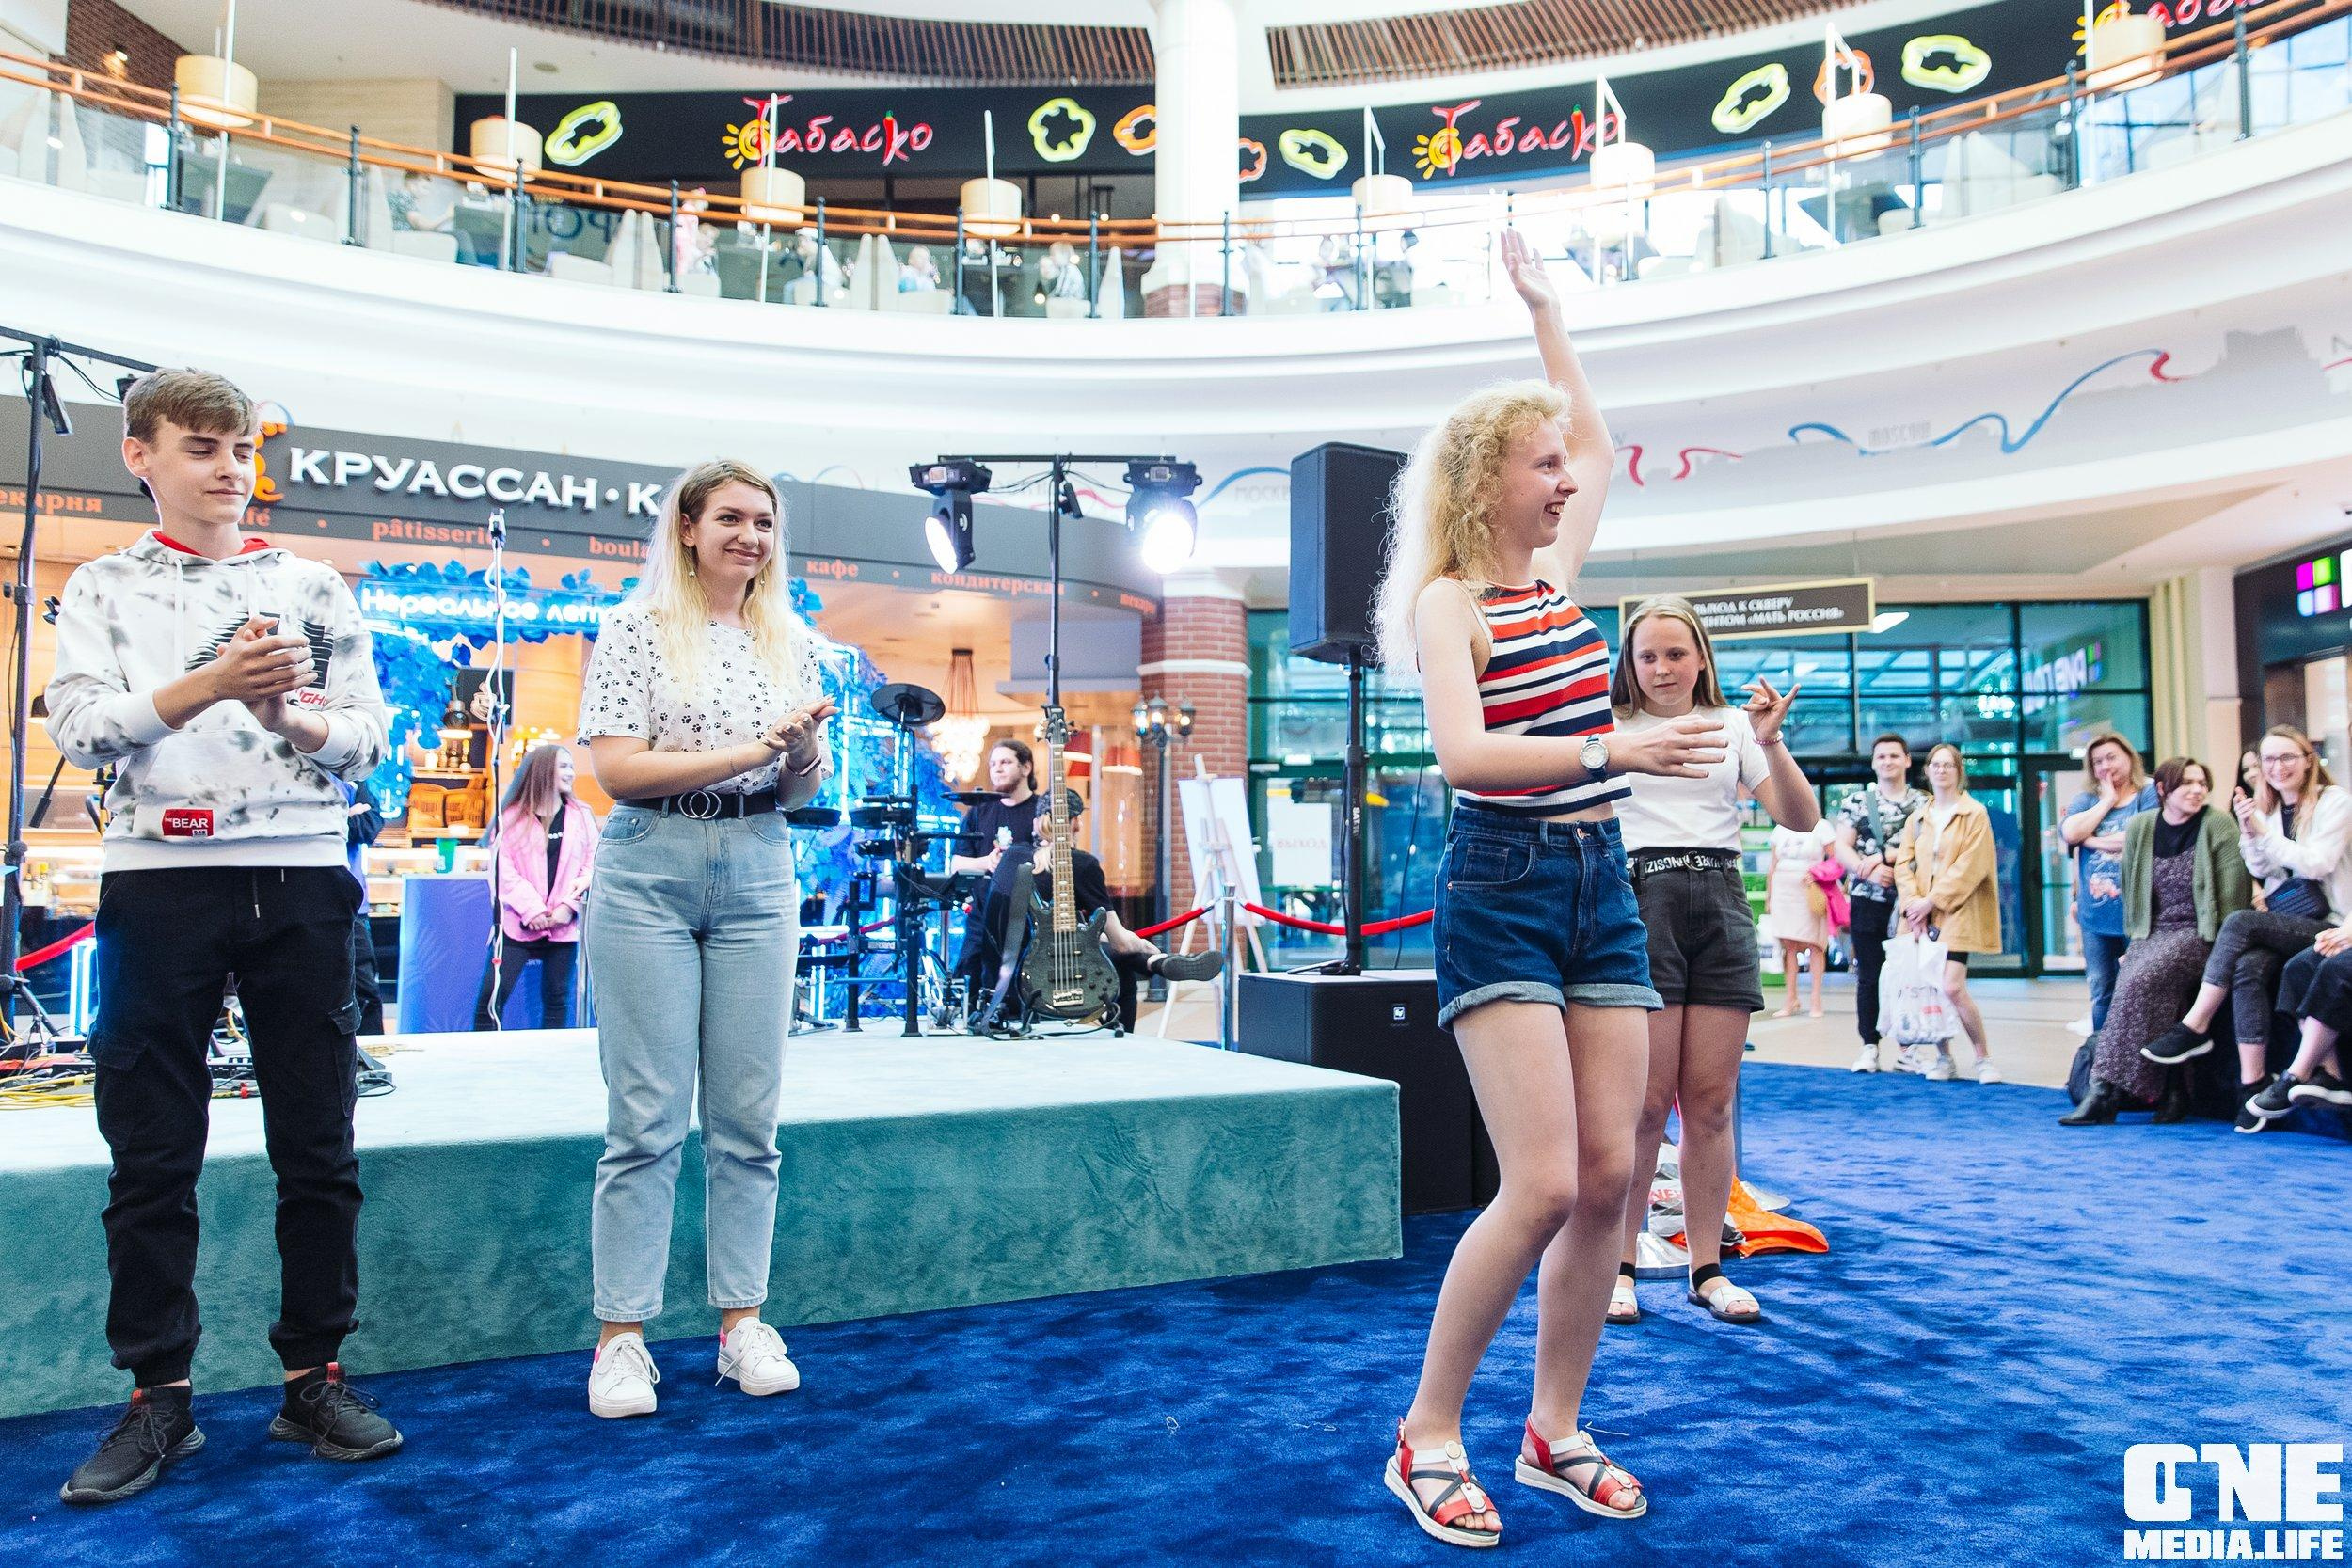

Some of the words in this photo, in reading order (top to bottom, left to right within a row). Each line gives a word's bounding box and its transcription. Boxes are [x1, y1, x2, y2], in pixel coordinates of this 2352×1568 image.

[743, 94, 933, 166] Табаско
[1431, 99, 1618, 176] Табаско
[289, 446, 598, 511] КРУАССАН
[806, 559, 859, 578] кафе
[546, 603, 608, 623] лет
[172, 817, 209, 828] BEAR
